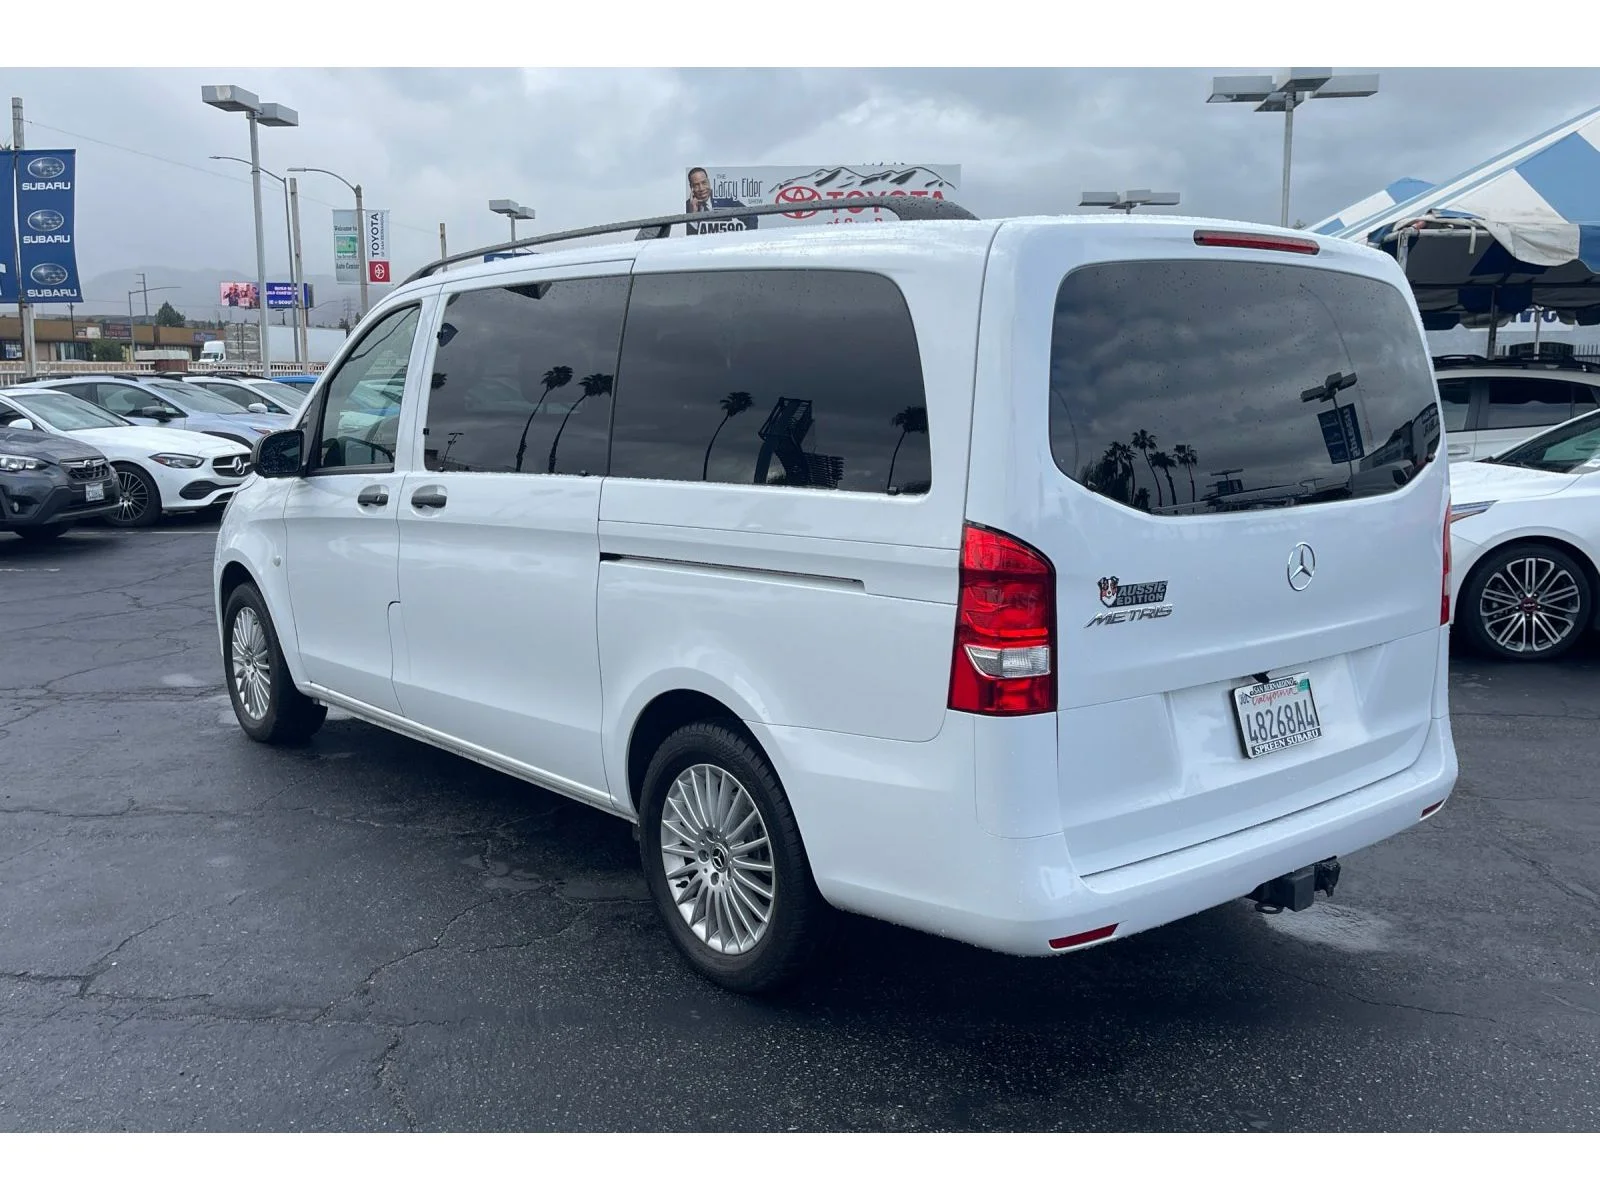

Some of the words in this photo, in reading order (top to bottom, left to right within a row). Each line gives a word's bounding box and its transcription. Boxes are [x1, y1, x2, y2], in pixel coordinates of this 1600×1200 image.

[22, 182, 71, 191] SUBARU
[713, 179, 738, 199] Larry
[742, 178, 763, 198] Elder
[826, 191, 944, 213] TOY
[371, 213, 380, 257] TOYOTA
[700, 222, 744, 234] AM590
[23, 235, 71, 244] SUBARU
[27, 288, 77, 298] SUBARU
[1117, 581, 1167, 597] AUSSIE
[1116, 593, 1164, 606] EDITION
[1083, 604, 1173, 628] METRIS
[1246, 699, 1315, 743] 48268A4
[1254, 738, 1286, 755] SPREEN
[1287, 730, 1319, 746] SUBARU
